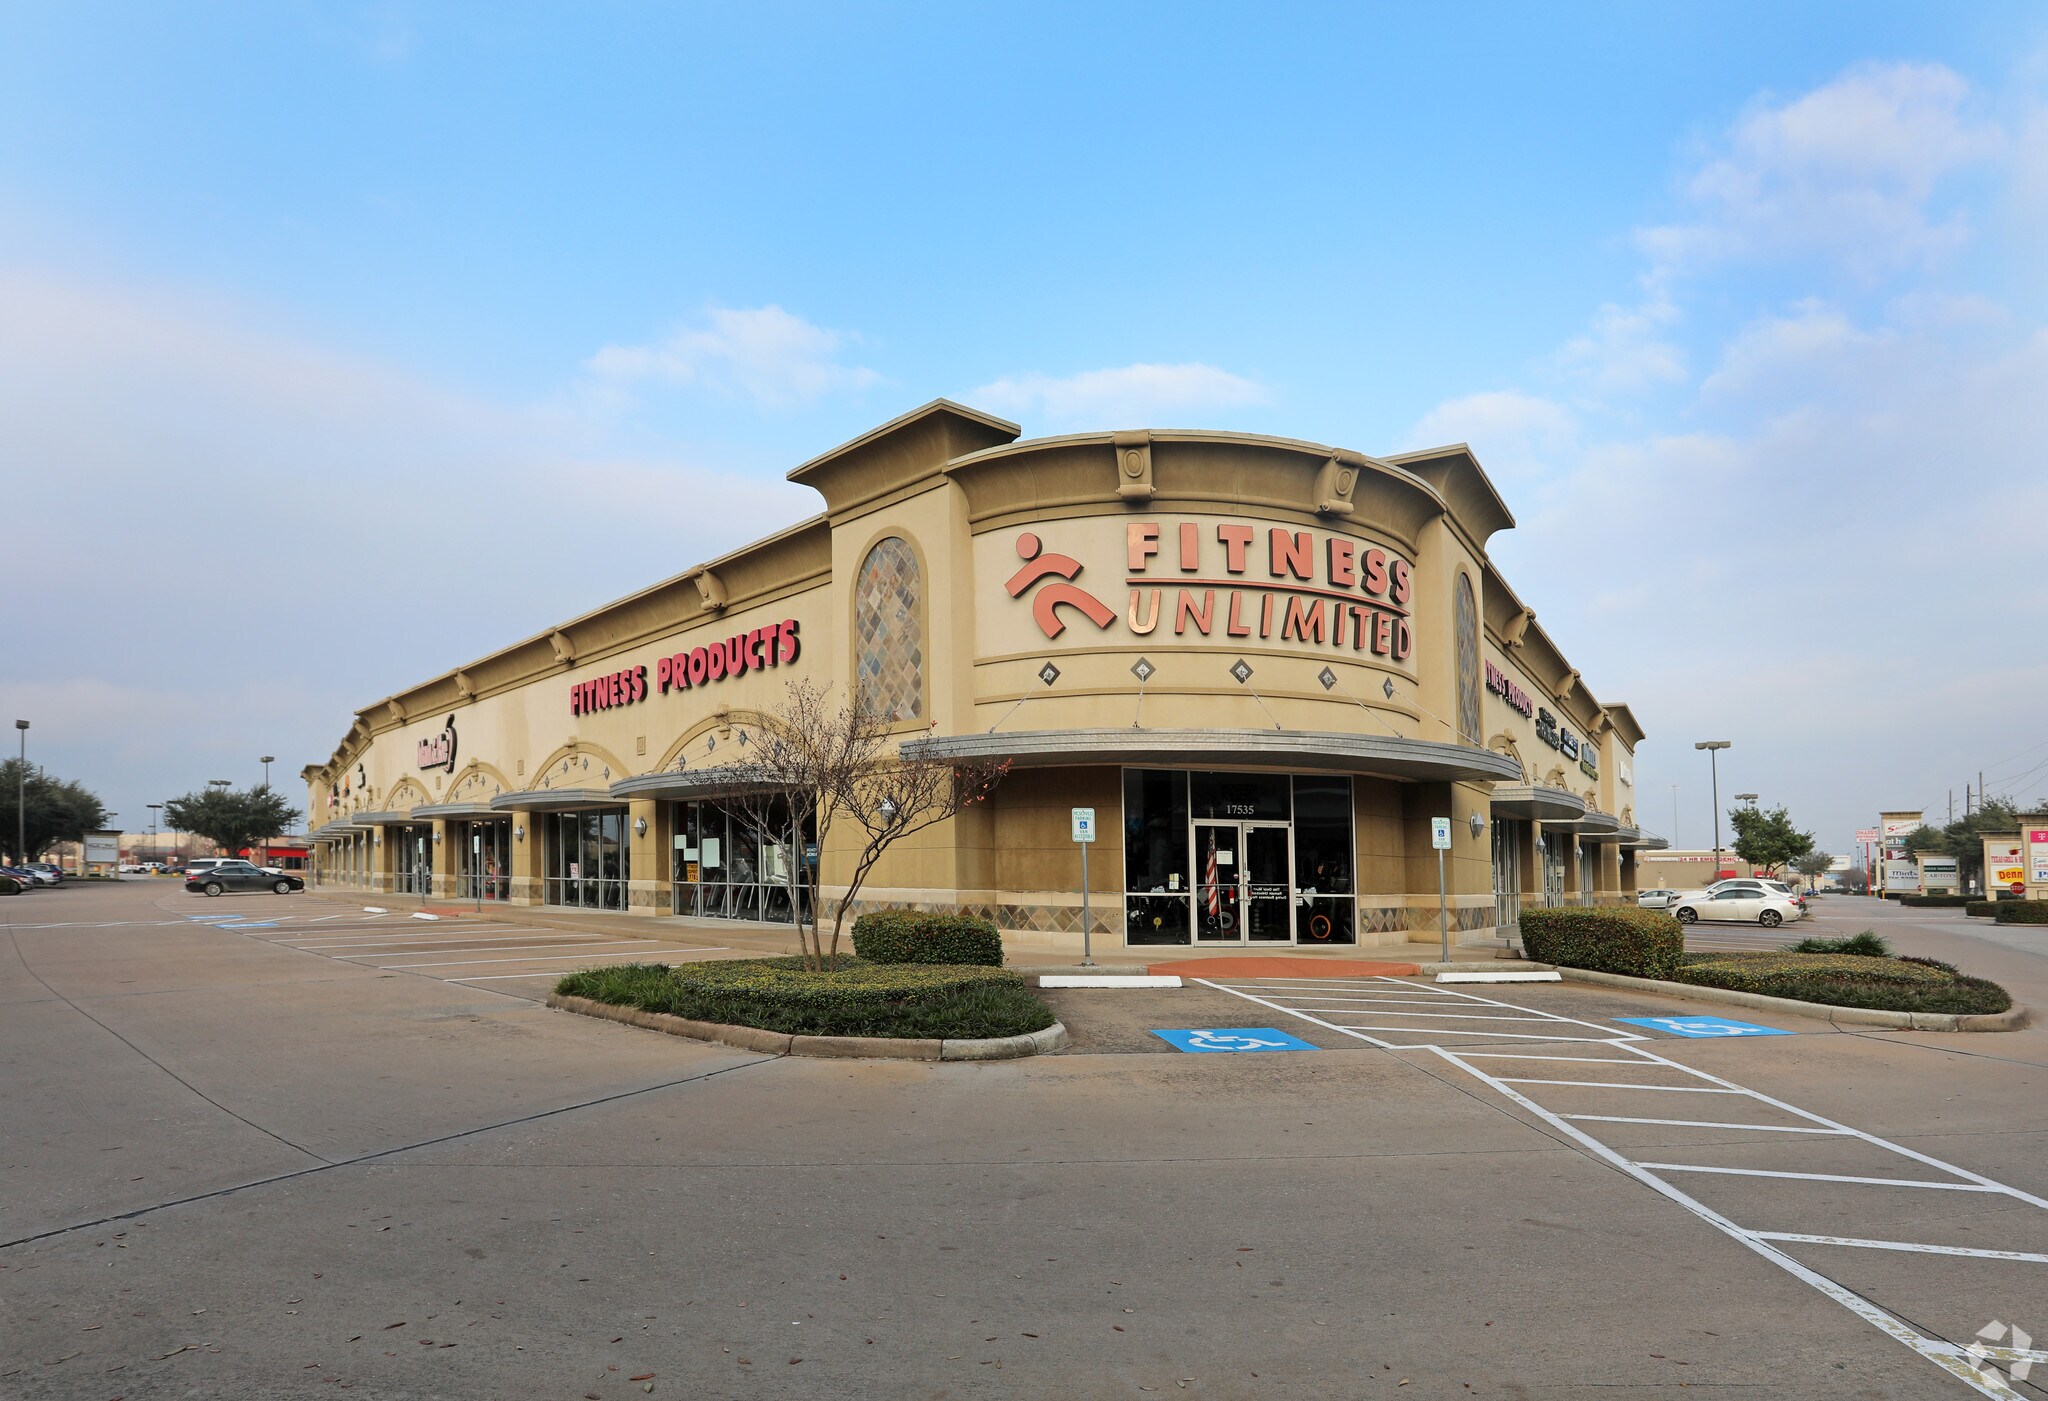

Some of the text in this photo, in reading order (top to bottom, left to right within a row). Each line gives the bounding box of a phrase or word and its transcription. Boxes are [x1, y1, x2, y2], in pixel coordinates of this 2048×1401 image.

[1127, 522, 1411, 605] FITNESS
[1127, 588, 1412, 661] UNLIMITED
[570, 618, 800, 717] FITNESS PRODUCTS
[1226, 804, 1254, 815] 17535
[1998, 871, 2023, 880] Denn
